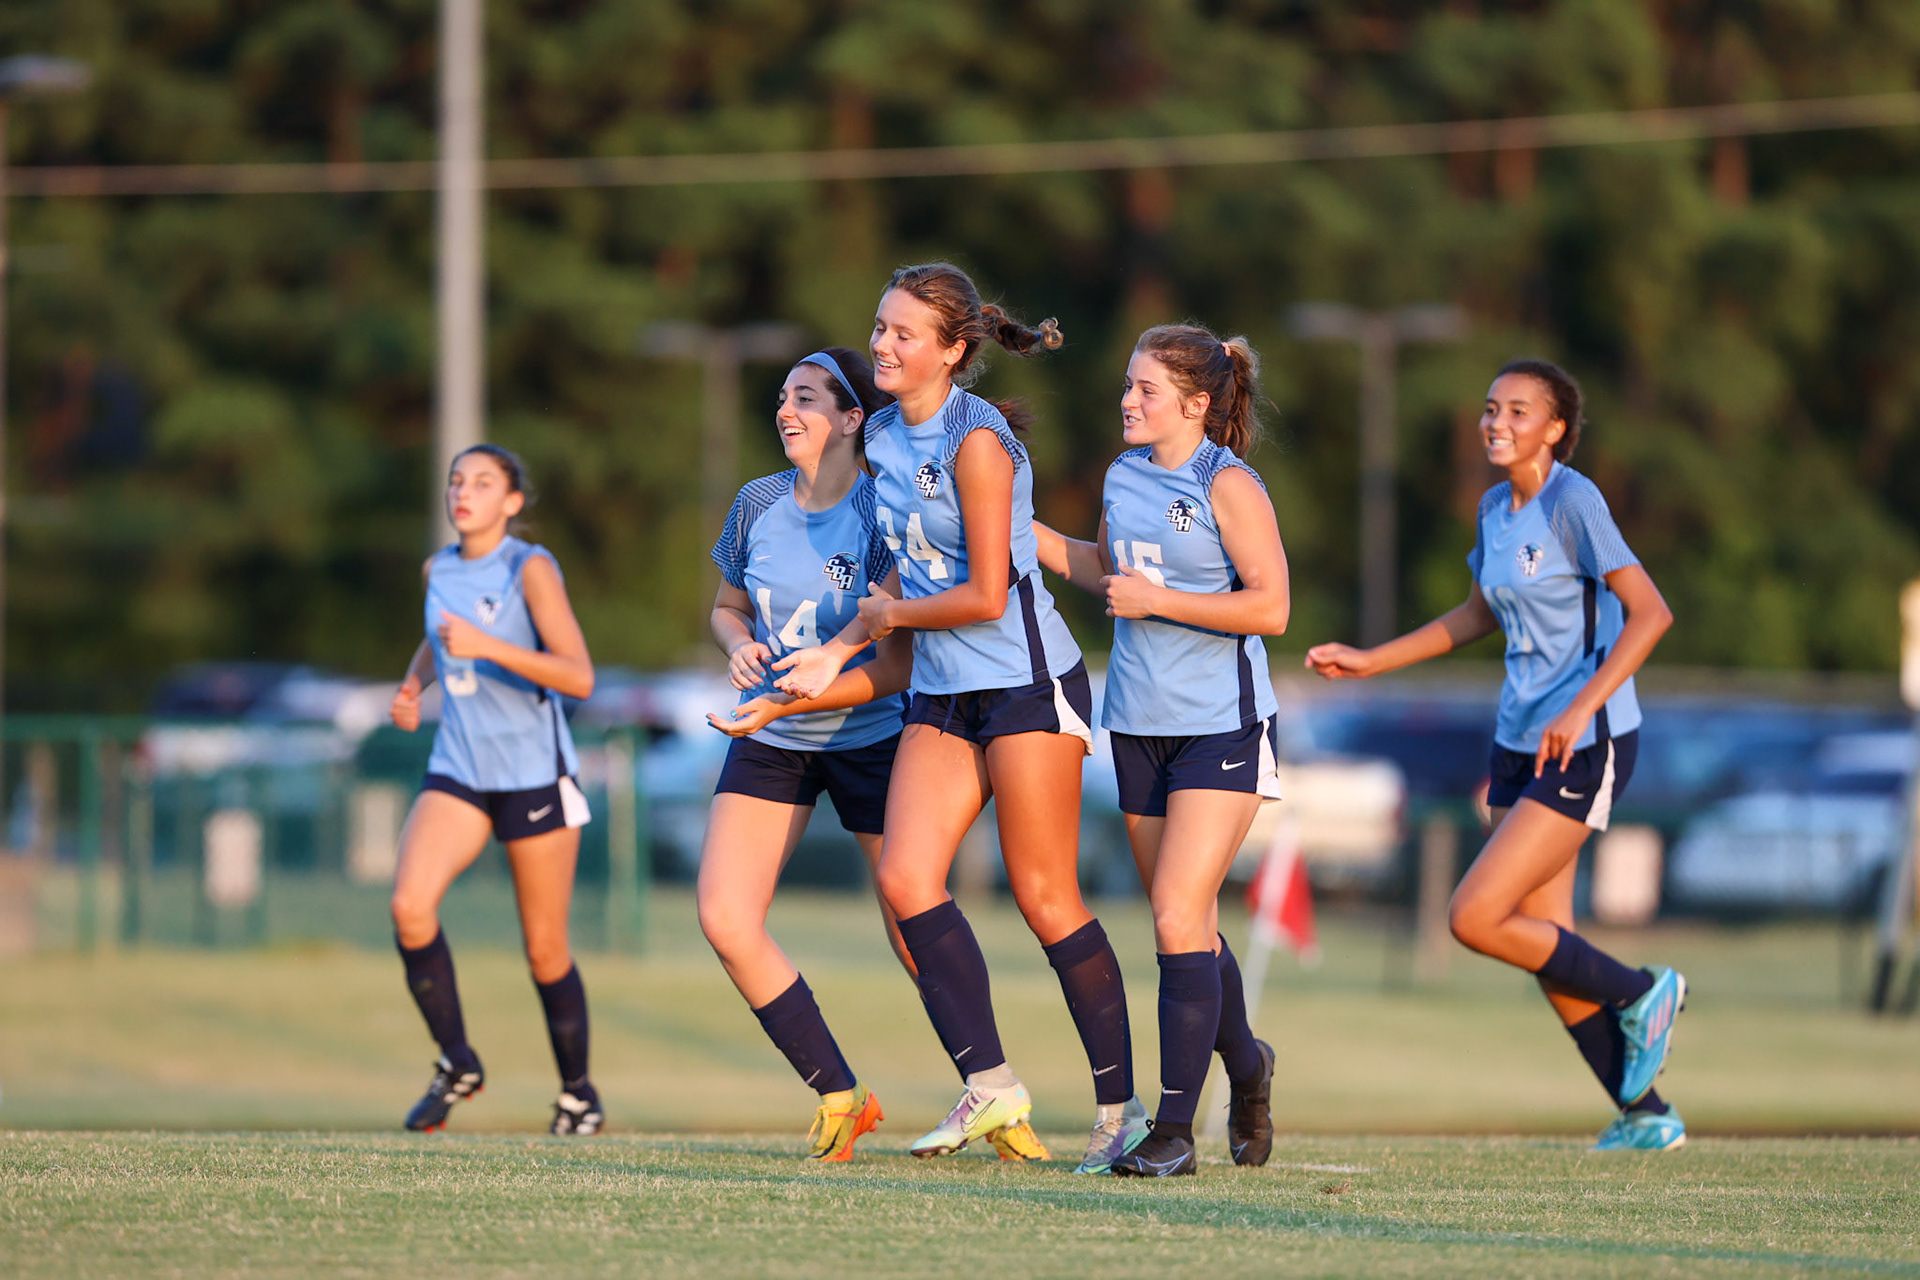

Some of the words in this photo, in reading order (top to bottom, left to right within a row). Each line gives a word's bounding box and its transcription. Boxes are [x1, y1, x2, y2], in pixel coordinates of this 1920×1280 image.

[914, 467, 938, 499] SBA
[1165, 502, 1192, 532] SBA
[824, 558, 855, 590] SBA
[756, 587, 822, 657] 14
